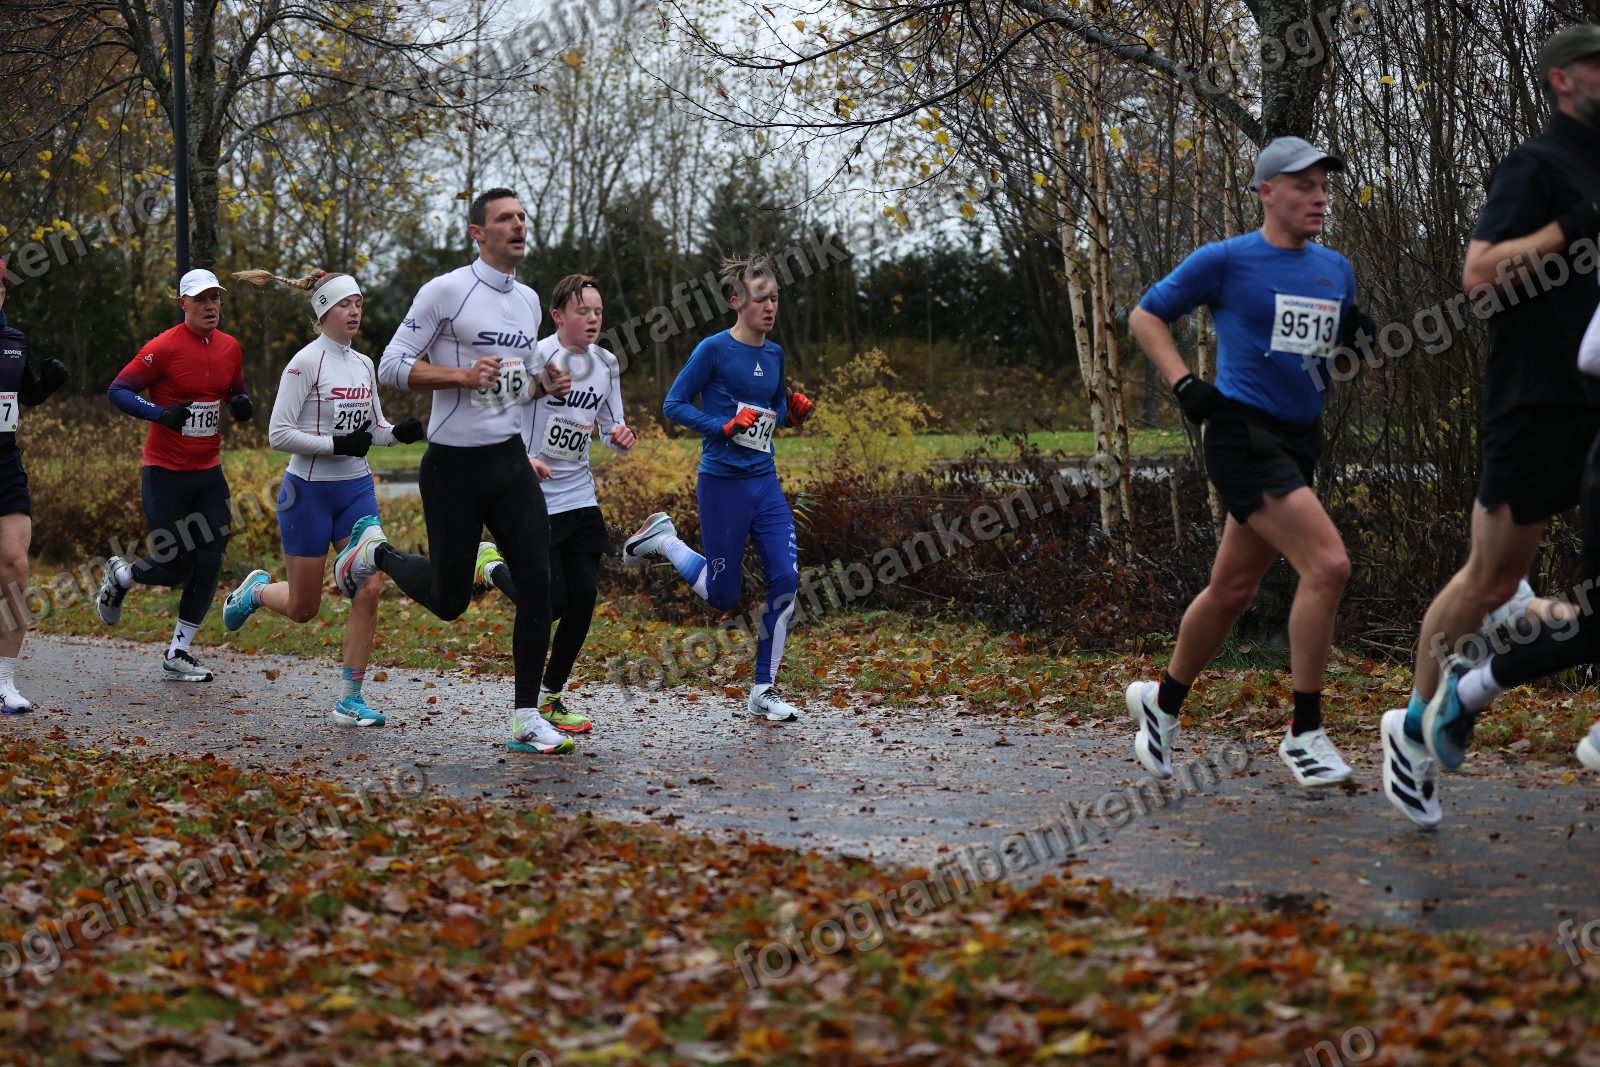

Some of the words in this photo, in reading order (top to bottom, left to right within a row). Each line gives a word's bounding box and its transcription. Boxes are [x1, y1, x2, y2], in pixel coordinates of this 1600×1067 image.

[1281, 311, 1334, 343] 9513
[191, 411, 219, 428] 1185
[547, 425, 589, 452] 9508
